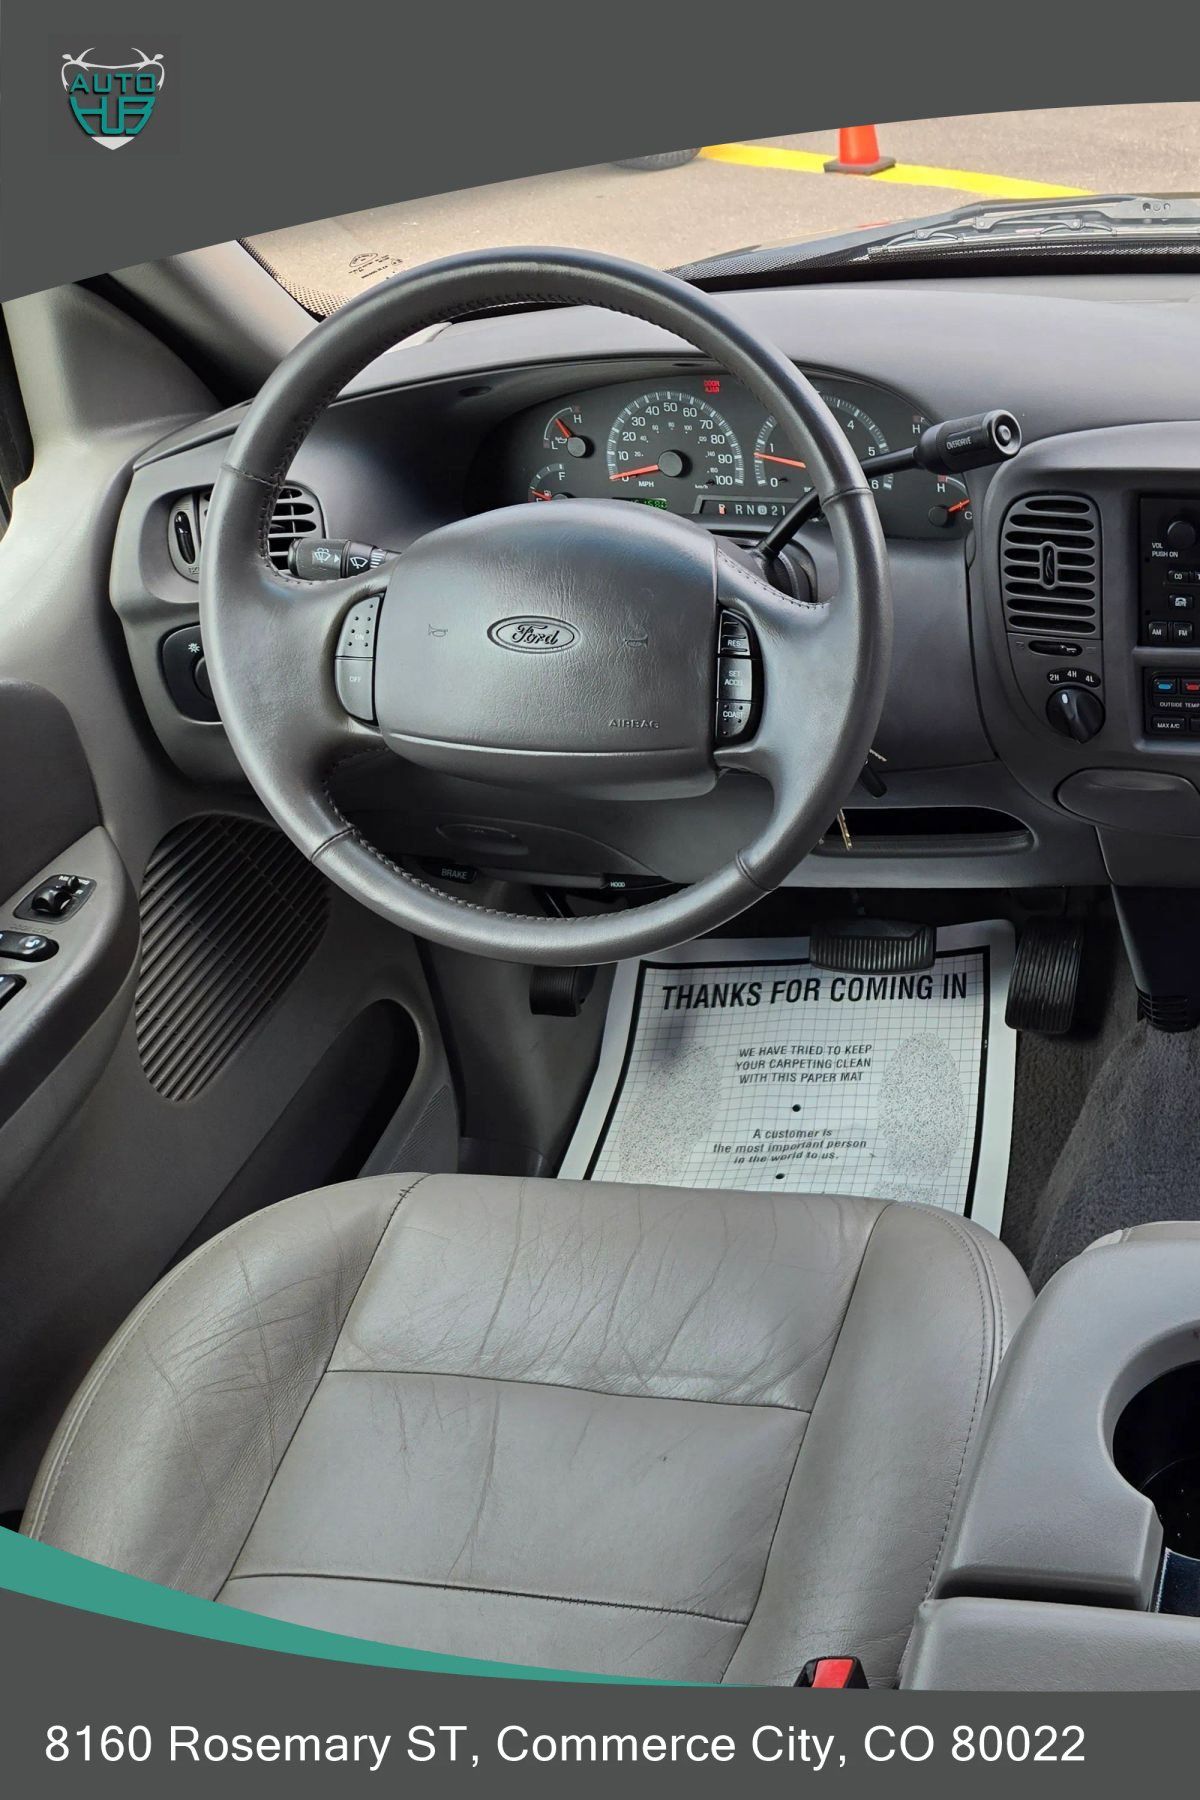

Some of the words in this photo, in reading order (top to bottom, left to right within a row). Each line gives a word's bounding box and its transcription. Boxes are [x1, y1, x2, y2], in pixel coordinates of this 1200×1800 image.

[645, 406, 660, 416] 40
[663, 402, 678, 412] 50
[683, 407, 697, 417] 60
[573, 414, 582, 423] H
[631, 417, 646, 426] 30
[700, 420, 713, 430] 70
[847, 420, 855, 430] 4
[912, 424, 920, 433] H
[622, 431, 637, 441] 20
[710, 434, 725, 444] 80
[551, 440, 558, 450] L
[769, 443, 774, 453] 1
[946, 436, 972, 450] OVERDRIVE
[617, 451, 629, 461] 10
[868, 446, 876, 456] 5
[718, 454, 733, 464] 90
[558, 471, 566, 480] F
[715, 475, 733, 486] 100
[770, 477, 778, 487] 0
[871, 480, 879, 490] 6
[937, 483, 946, 493] H
[735, 504, 743, 515] R
[746, 504, 755, 515] N
[771, 505, 778, 516] 2
[964, 511, 973, 520] C
[511, 624, 560, 645] Ford
[1067, 670, 1077, 678] 4H
[1085, 675, 1094, 683] 4L
[723, 710, 743, 718] COAST
[608, 719, 660, 729] AIRBAG
[441, 868, 467, 880] BRAKE
[662, 982, 763, 1010] THANKS
[770, 979, 821, 1004] FOR
[830, 974, 933, 1001] COMING
[943, 972, 968, 1000] IN
[739, 1047, 756, 1057] WE
[759, 1045, 787, 1056] HAVE
[791, 1045, 823, 1055] TRIED
[828, 1045, 841, 1055] TO
[844, 1044, 873, 1054] KEEP
[736, 1060, 765, 1071] YOUR
[769, 1058, 832, 1069] CARPETING
[836, 1057, 872, 1068] CLEAN
[739, 1074, 768, 1084] WITH
[772, 1073, 797, 1083] THIS
[800, 1073, 837, 1083] PAPER
[840, 1071, 864, 1081] MAT
[752, 1129, 761, 1139] A
[764, 1129, 820, 1139] customer
[822, 1129, 833, 1137] is
[713, 1143, 731, 1153] the
[736, 1143, 764, 1153] most
[767, 1140, 824, 1151] important
[826, 1139, 867, 1149] person
[733, 1156, 745, 1164] in
[749, 1155, 767, 1163] the
[771, 1152, 803, 1162] world
[806, 1151, 818, 1159] to
[821, 1151, 839, 1160] us.
